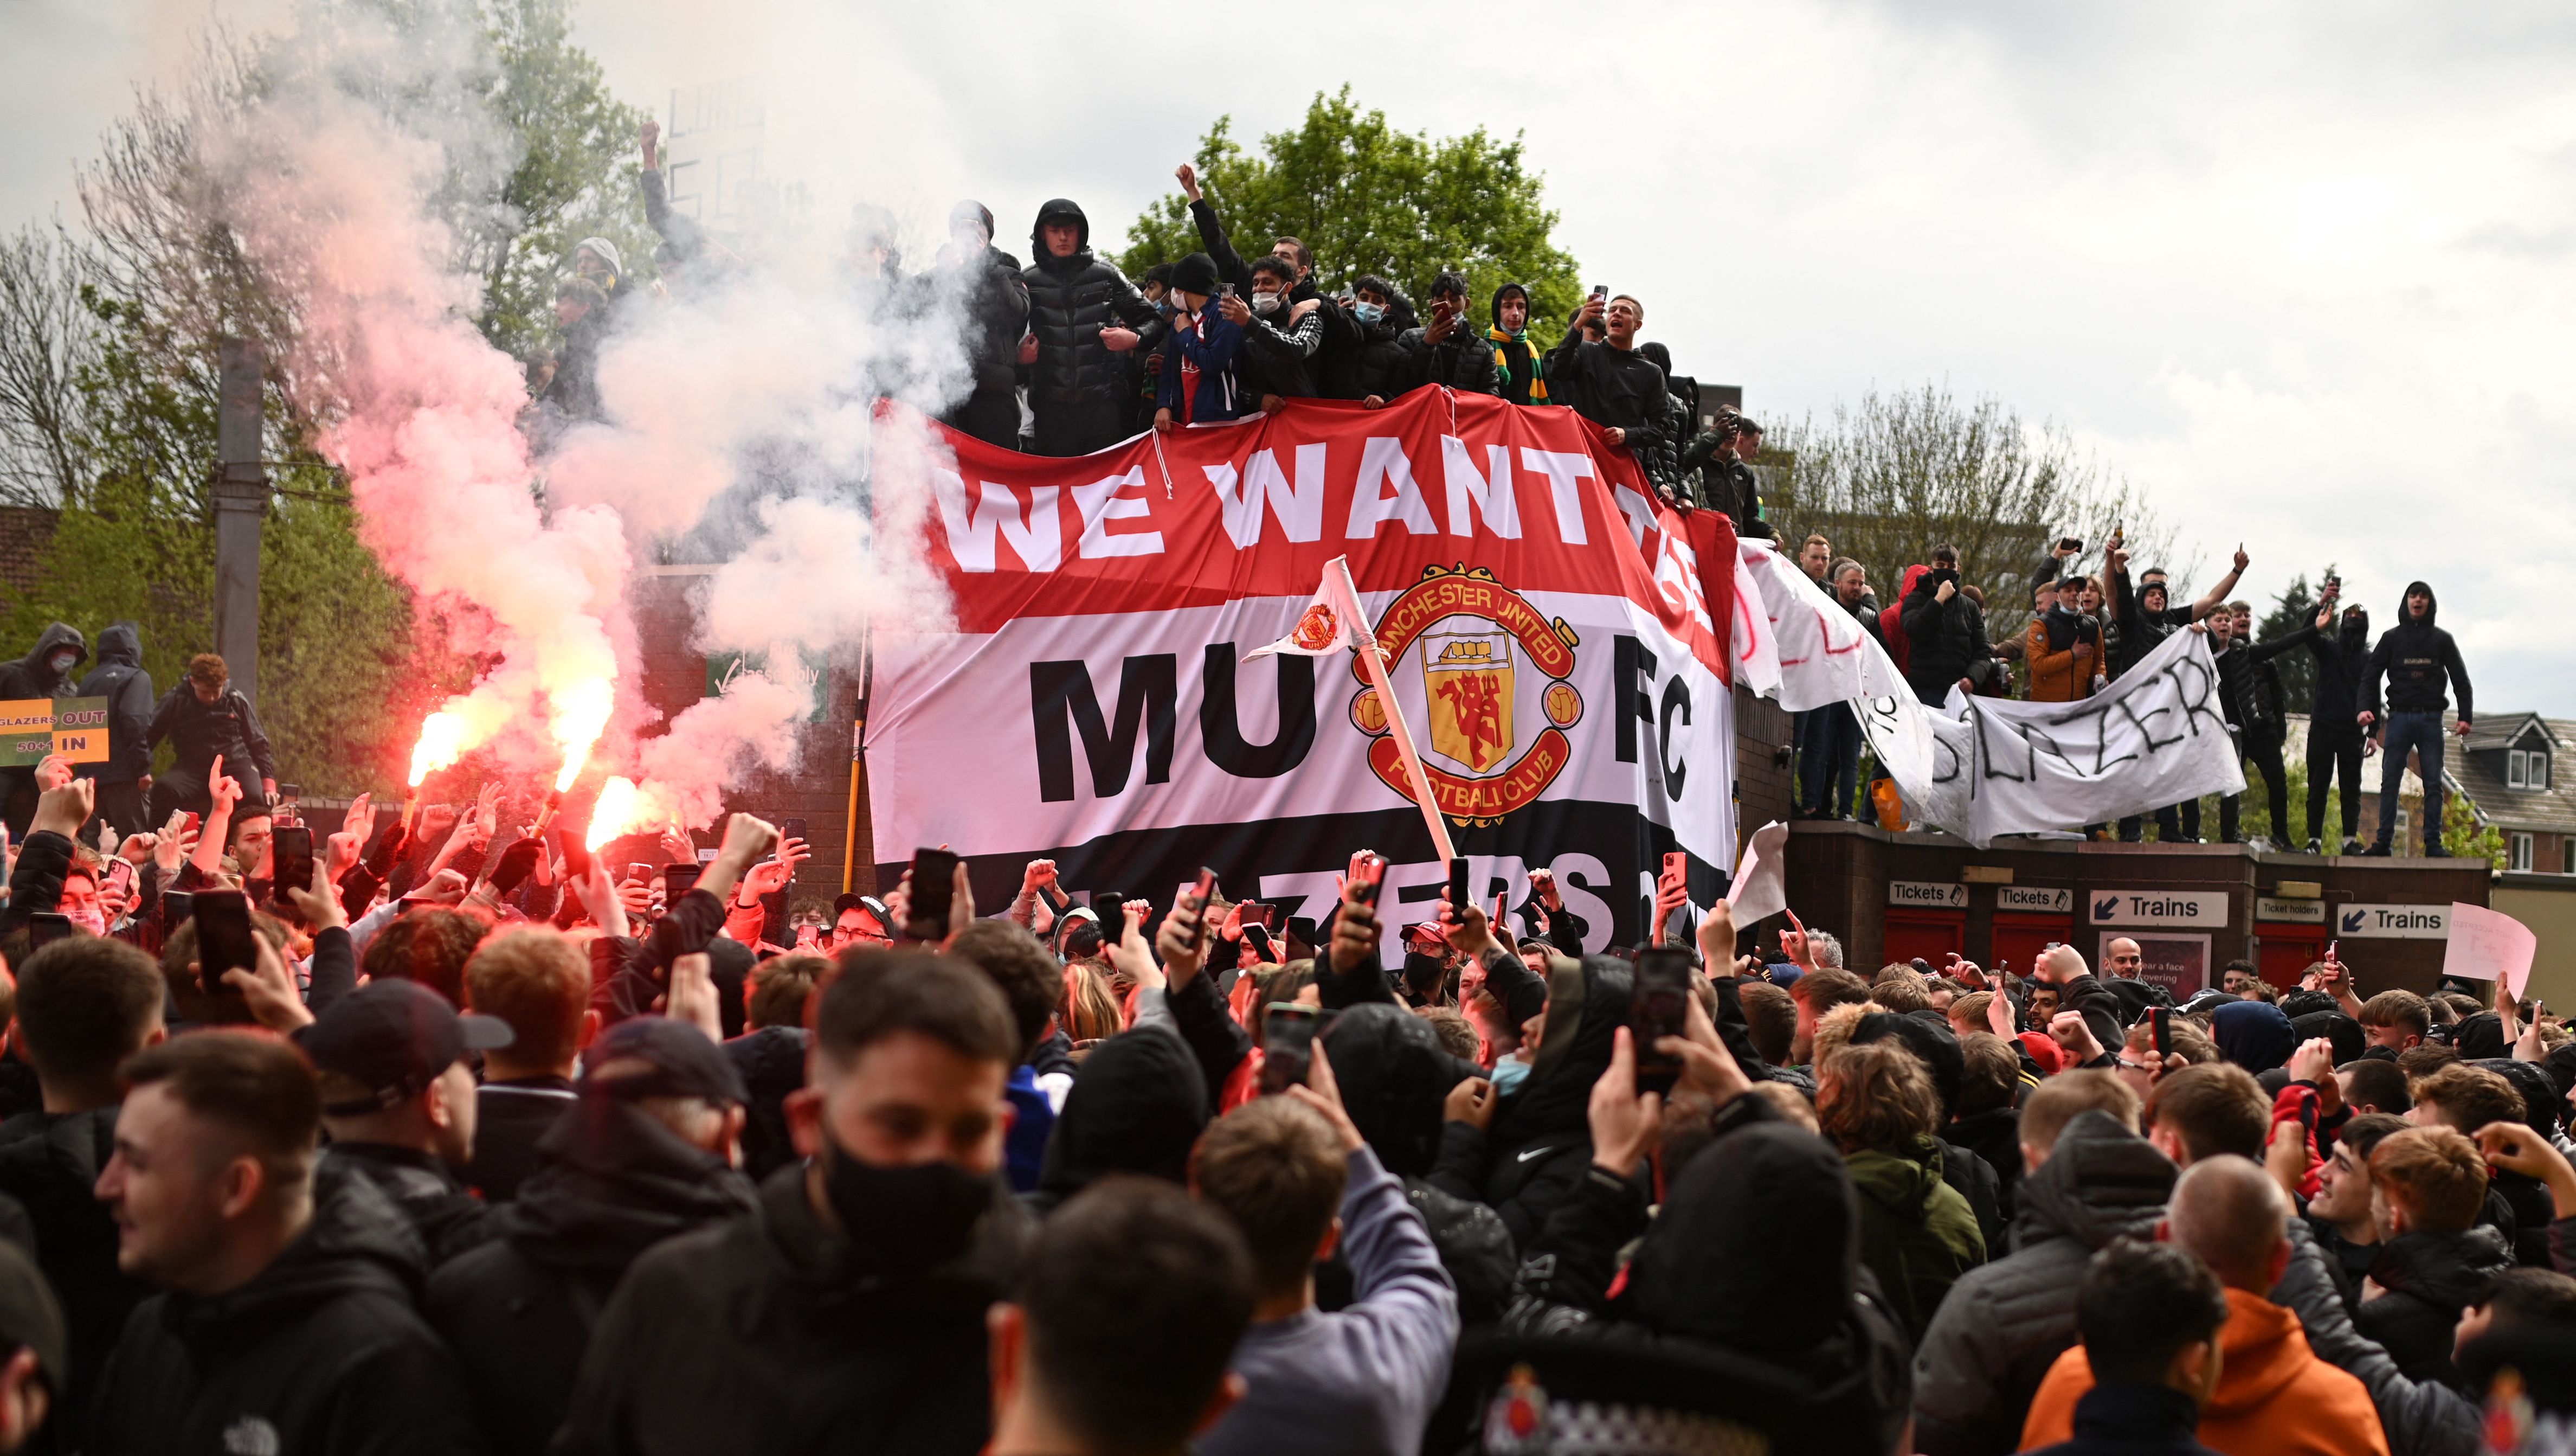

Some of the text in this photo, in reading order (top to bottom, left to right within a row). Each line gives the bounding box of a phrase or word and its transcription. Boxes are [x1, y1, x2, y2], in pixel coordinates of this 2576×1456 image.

[935, 465, 1165, 572] WE
[1202, 433, 1596, 550] WANT
[1380, 582, 1562, 665] ANCHESTER UNITED
[1308, 631, 1334, 648] UNITED
[62, 710, 106, 725] OUT
[1030, 642, 1317, 803] MU
[1614, 634, 1692, 803] FC
[17, 736, 87, 752] 50+1 IN
[1503, 749, 1554, 801] CLUB
[1894, 884, 1944, 901] Tickets
[2002, 889, 2050, 905] Tickets
[2129, 896, 2199, 917] Trains
[2264, 903, 2319, 915] Ticket holders
[2375, 909, 2442, 929] Trains
[2166, 962, 2185, 972] face
